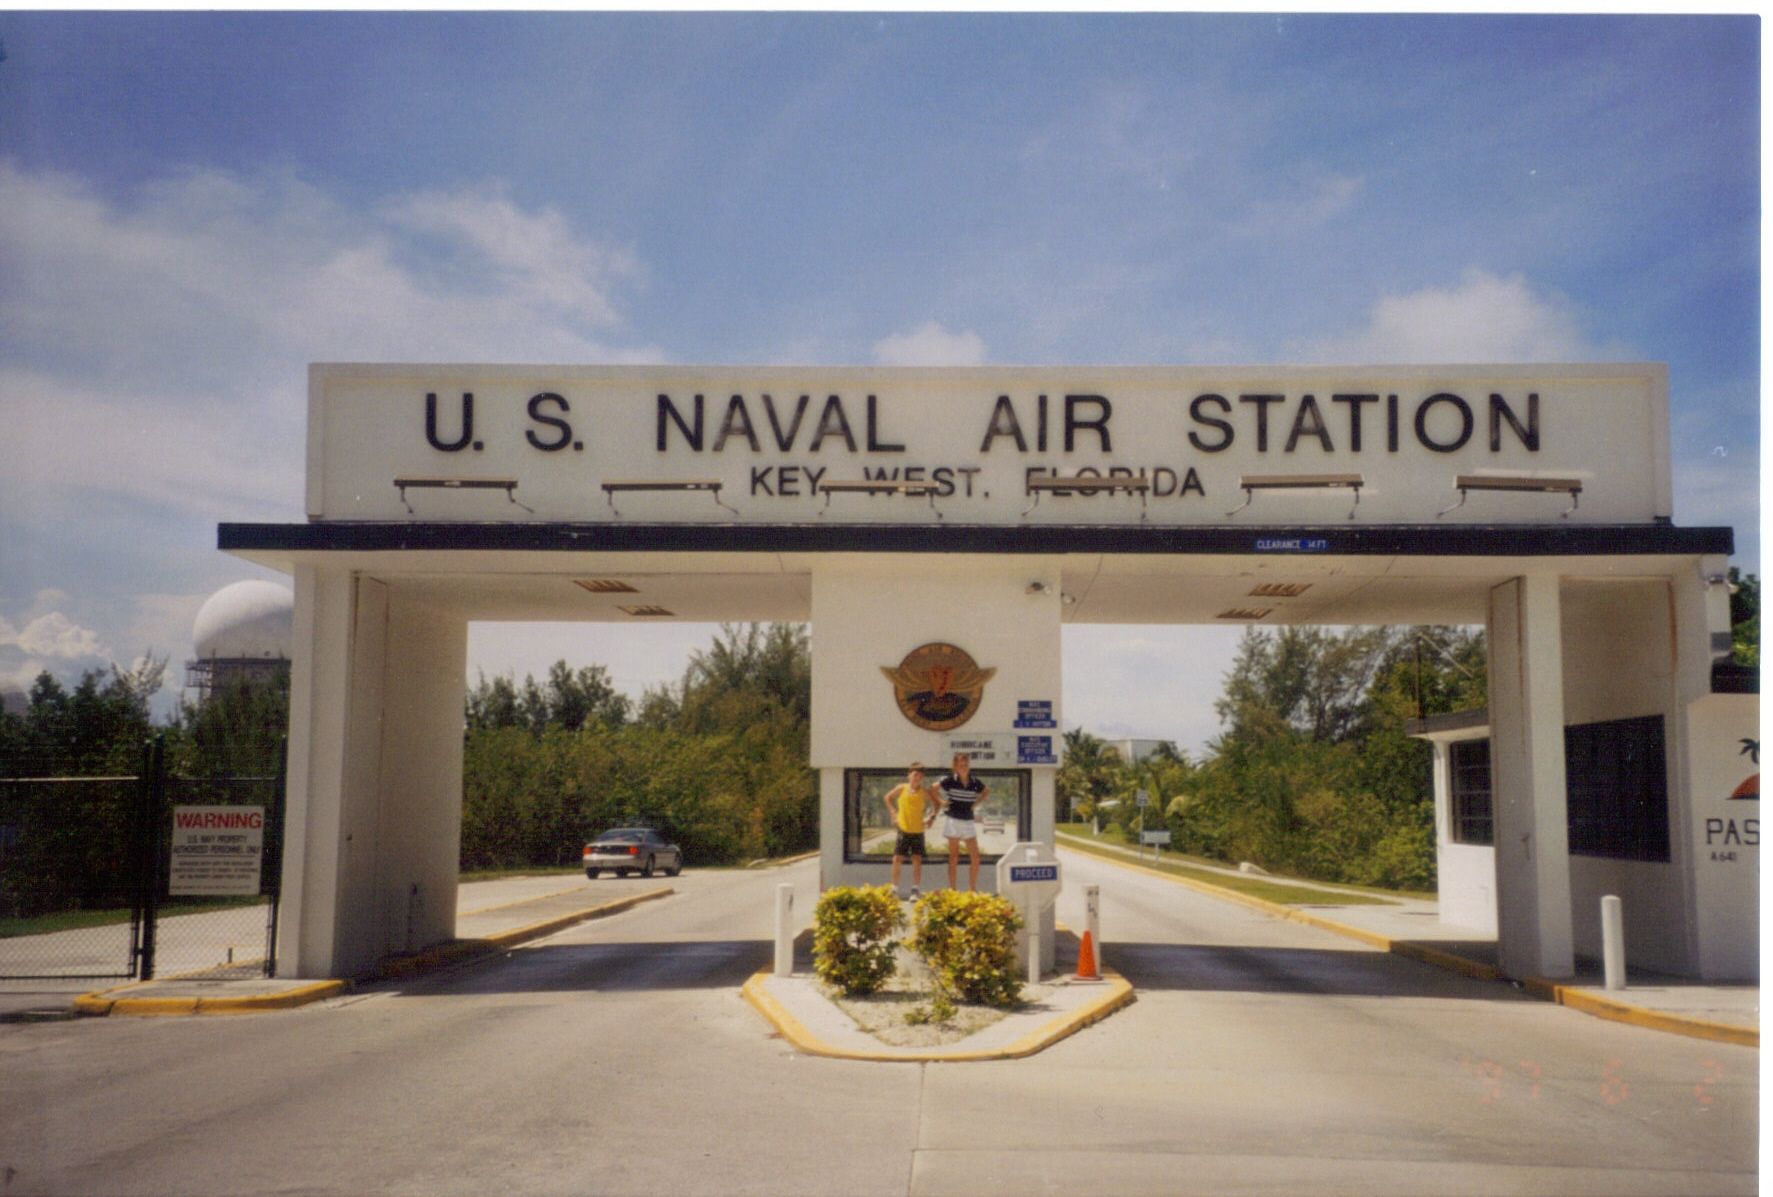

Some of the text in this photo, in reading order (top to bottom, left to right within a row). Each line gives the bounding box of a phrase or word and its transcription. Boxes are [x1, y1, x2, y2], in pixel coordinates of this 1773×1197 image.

[425, 392, 1541, 454] U. S. NAVAL AIR STATION
[751, 466, 828, 497] KEY
[1257, 540, 1300, 549] CLEARANCE
[950, 741, 992, 749] HURRICANE
[176, 812, 262, 829] WARNING
[1015, 867, 1053, 879] PROCEED
